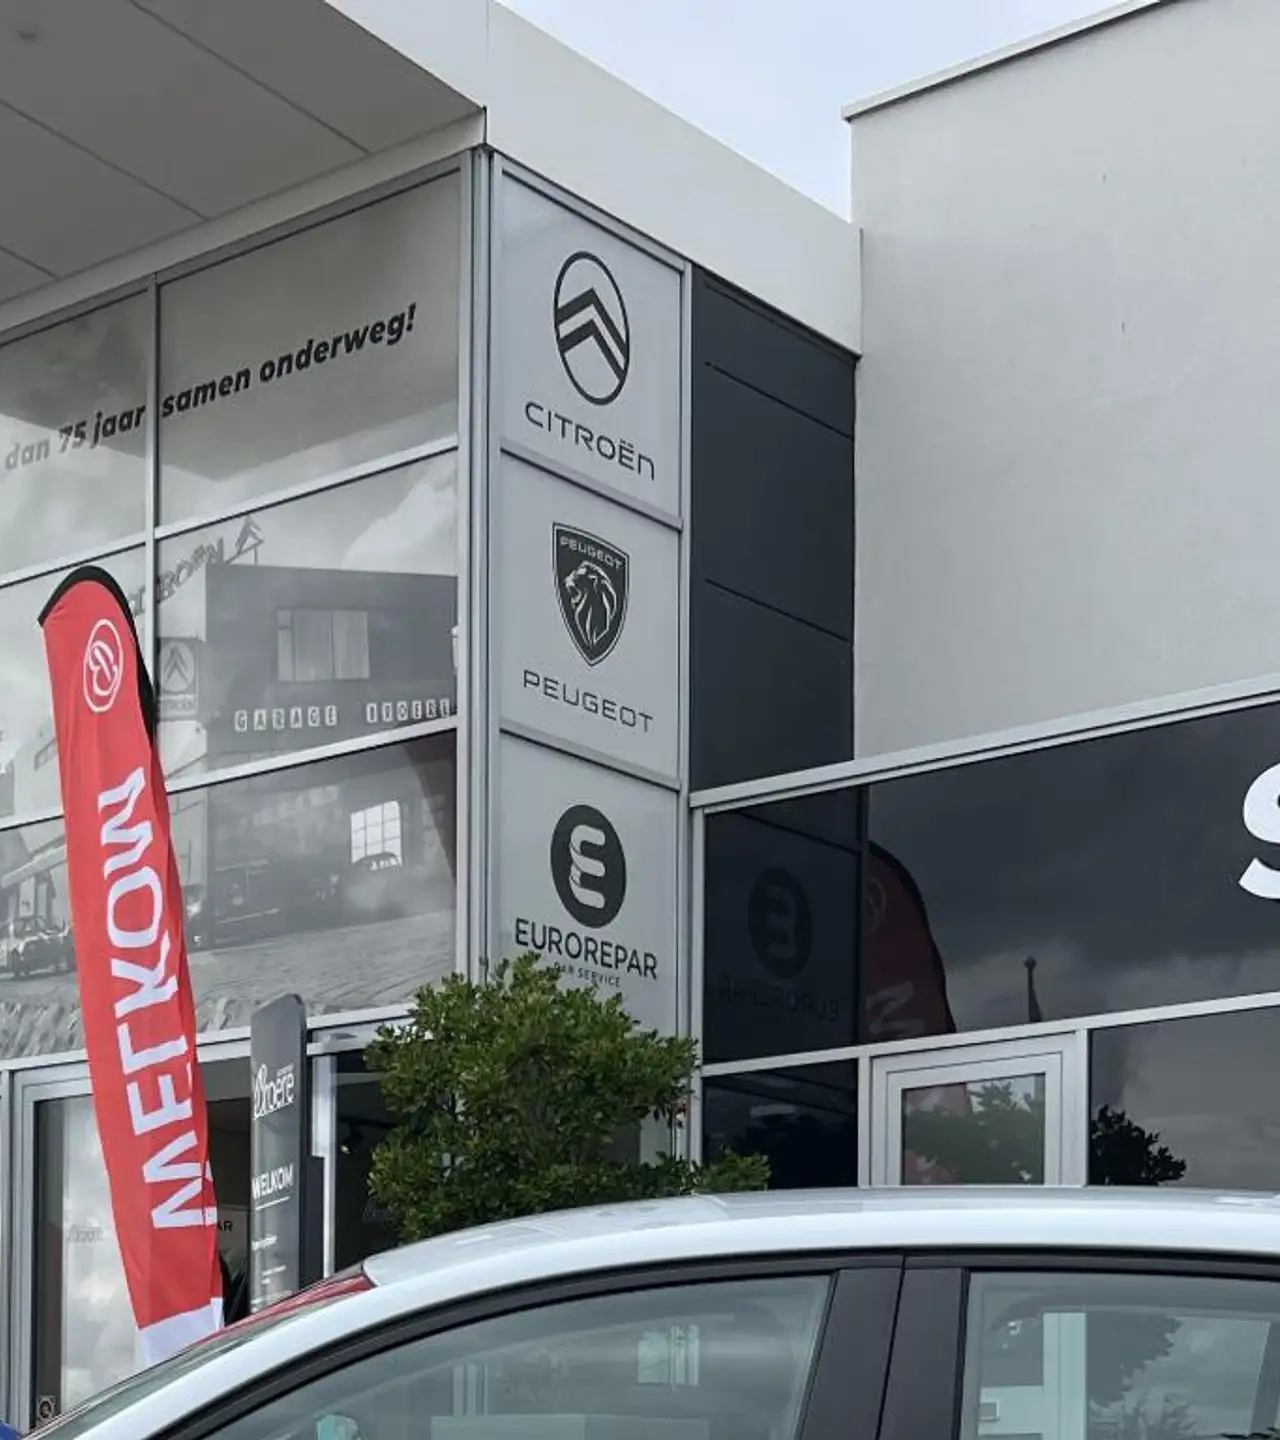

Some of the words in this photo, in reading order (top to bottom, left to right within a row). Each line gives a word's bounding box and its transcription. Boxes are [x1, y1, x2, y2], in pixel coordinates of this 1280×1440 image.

[5, 437, 51, 470] dan
[58, 421, 88, 454] 75
[90, 403, 147, 449] jaar
[161, 368, 251, 418] samen
[259, 303, 417, 383] onderweg!
[560, 535, 622, 569] PEUGEOT
[523, 669, 654, 733] PEUGEOT
[514, 918, 658, 981] EUROREPAR
[251, 1163, 294, 1200] WELKOM
